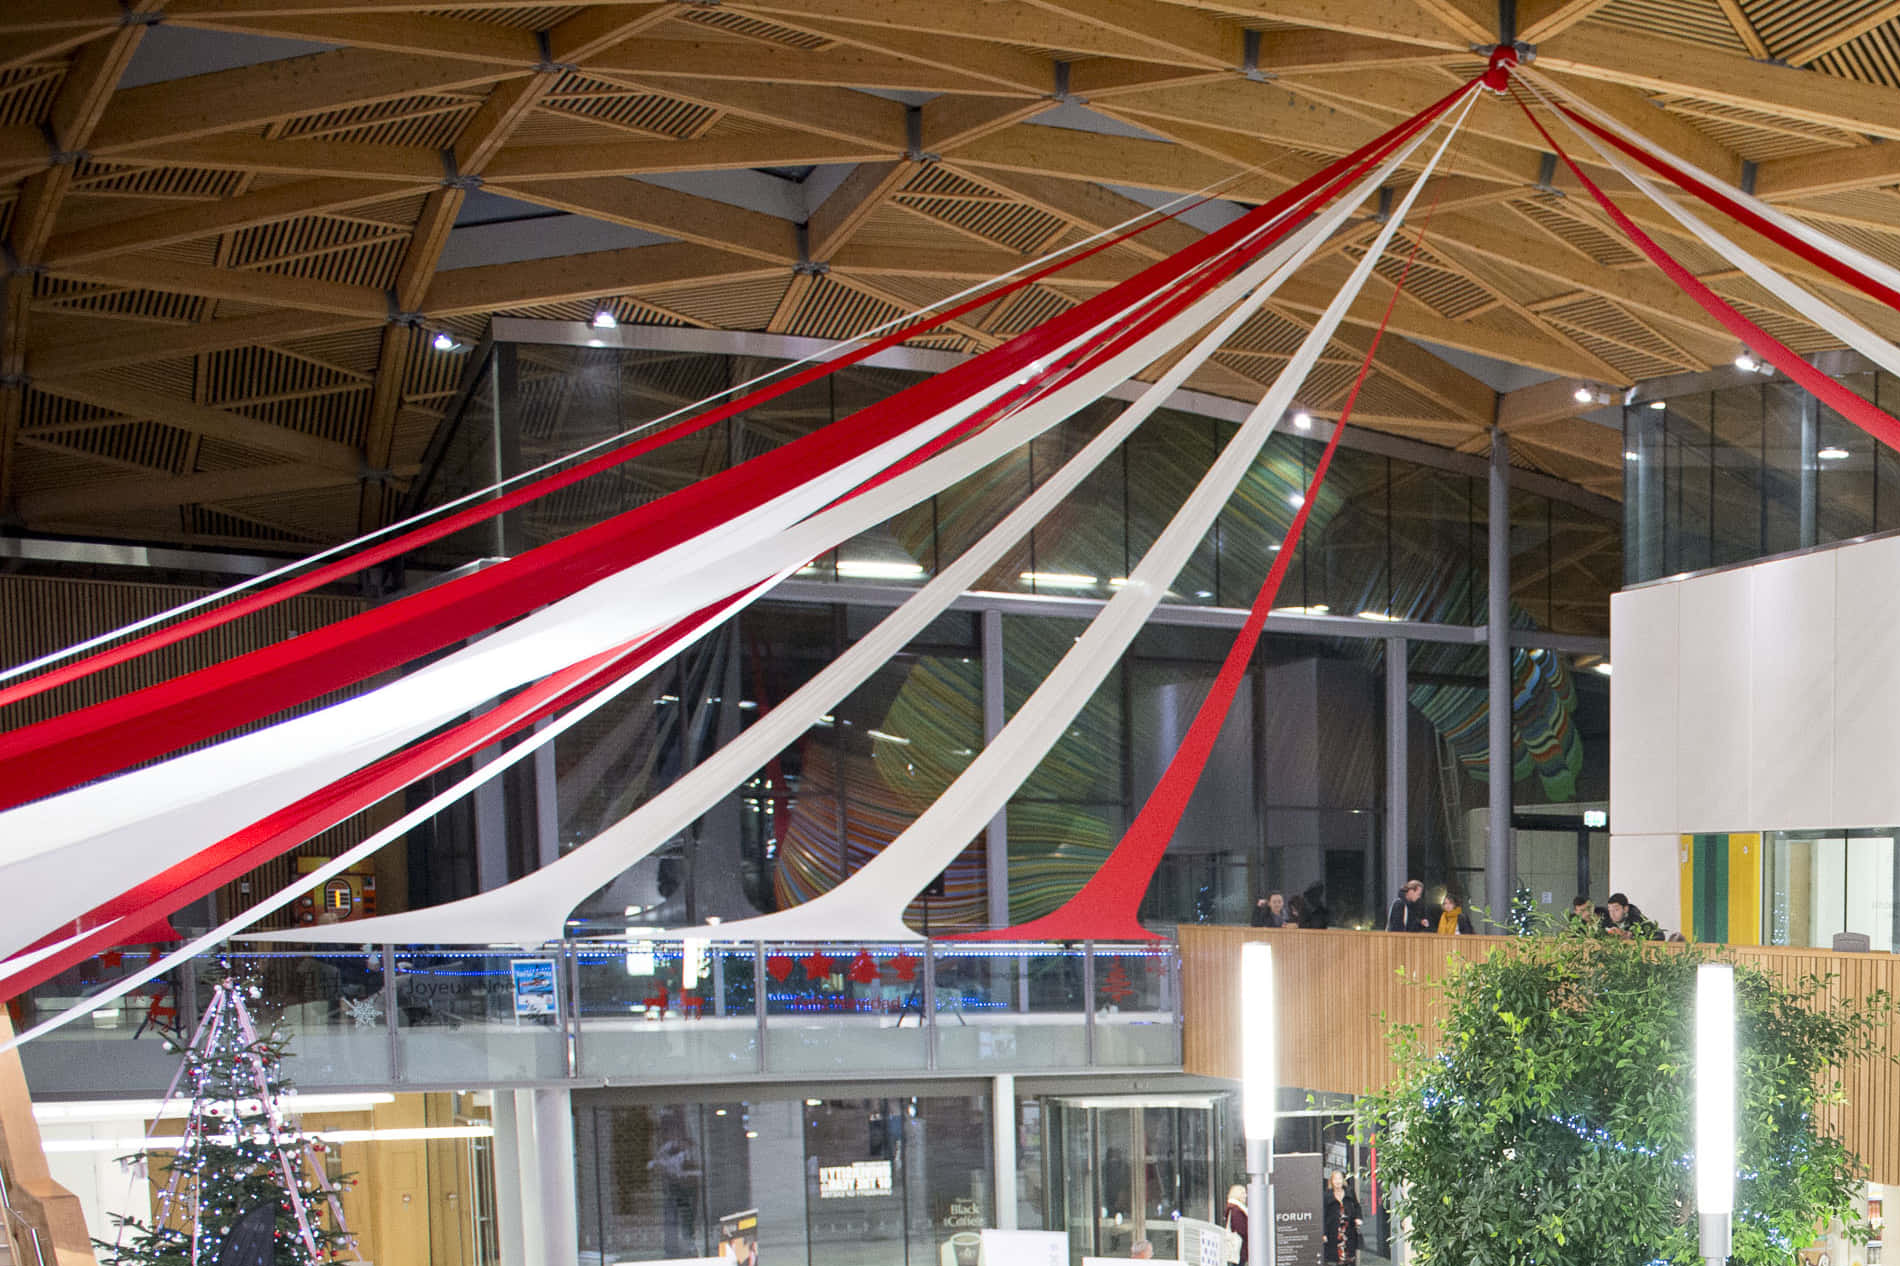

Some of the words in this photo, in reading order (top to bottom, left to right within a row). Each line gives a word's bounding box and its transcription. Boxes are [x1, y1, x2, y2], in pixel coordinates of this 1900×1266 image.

[408, 976, 472, 997] Joyeux
[951, 1203, 981, 1215] Black
[1276, 1212, 1313, 1222] FORUM
